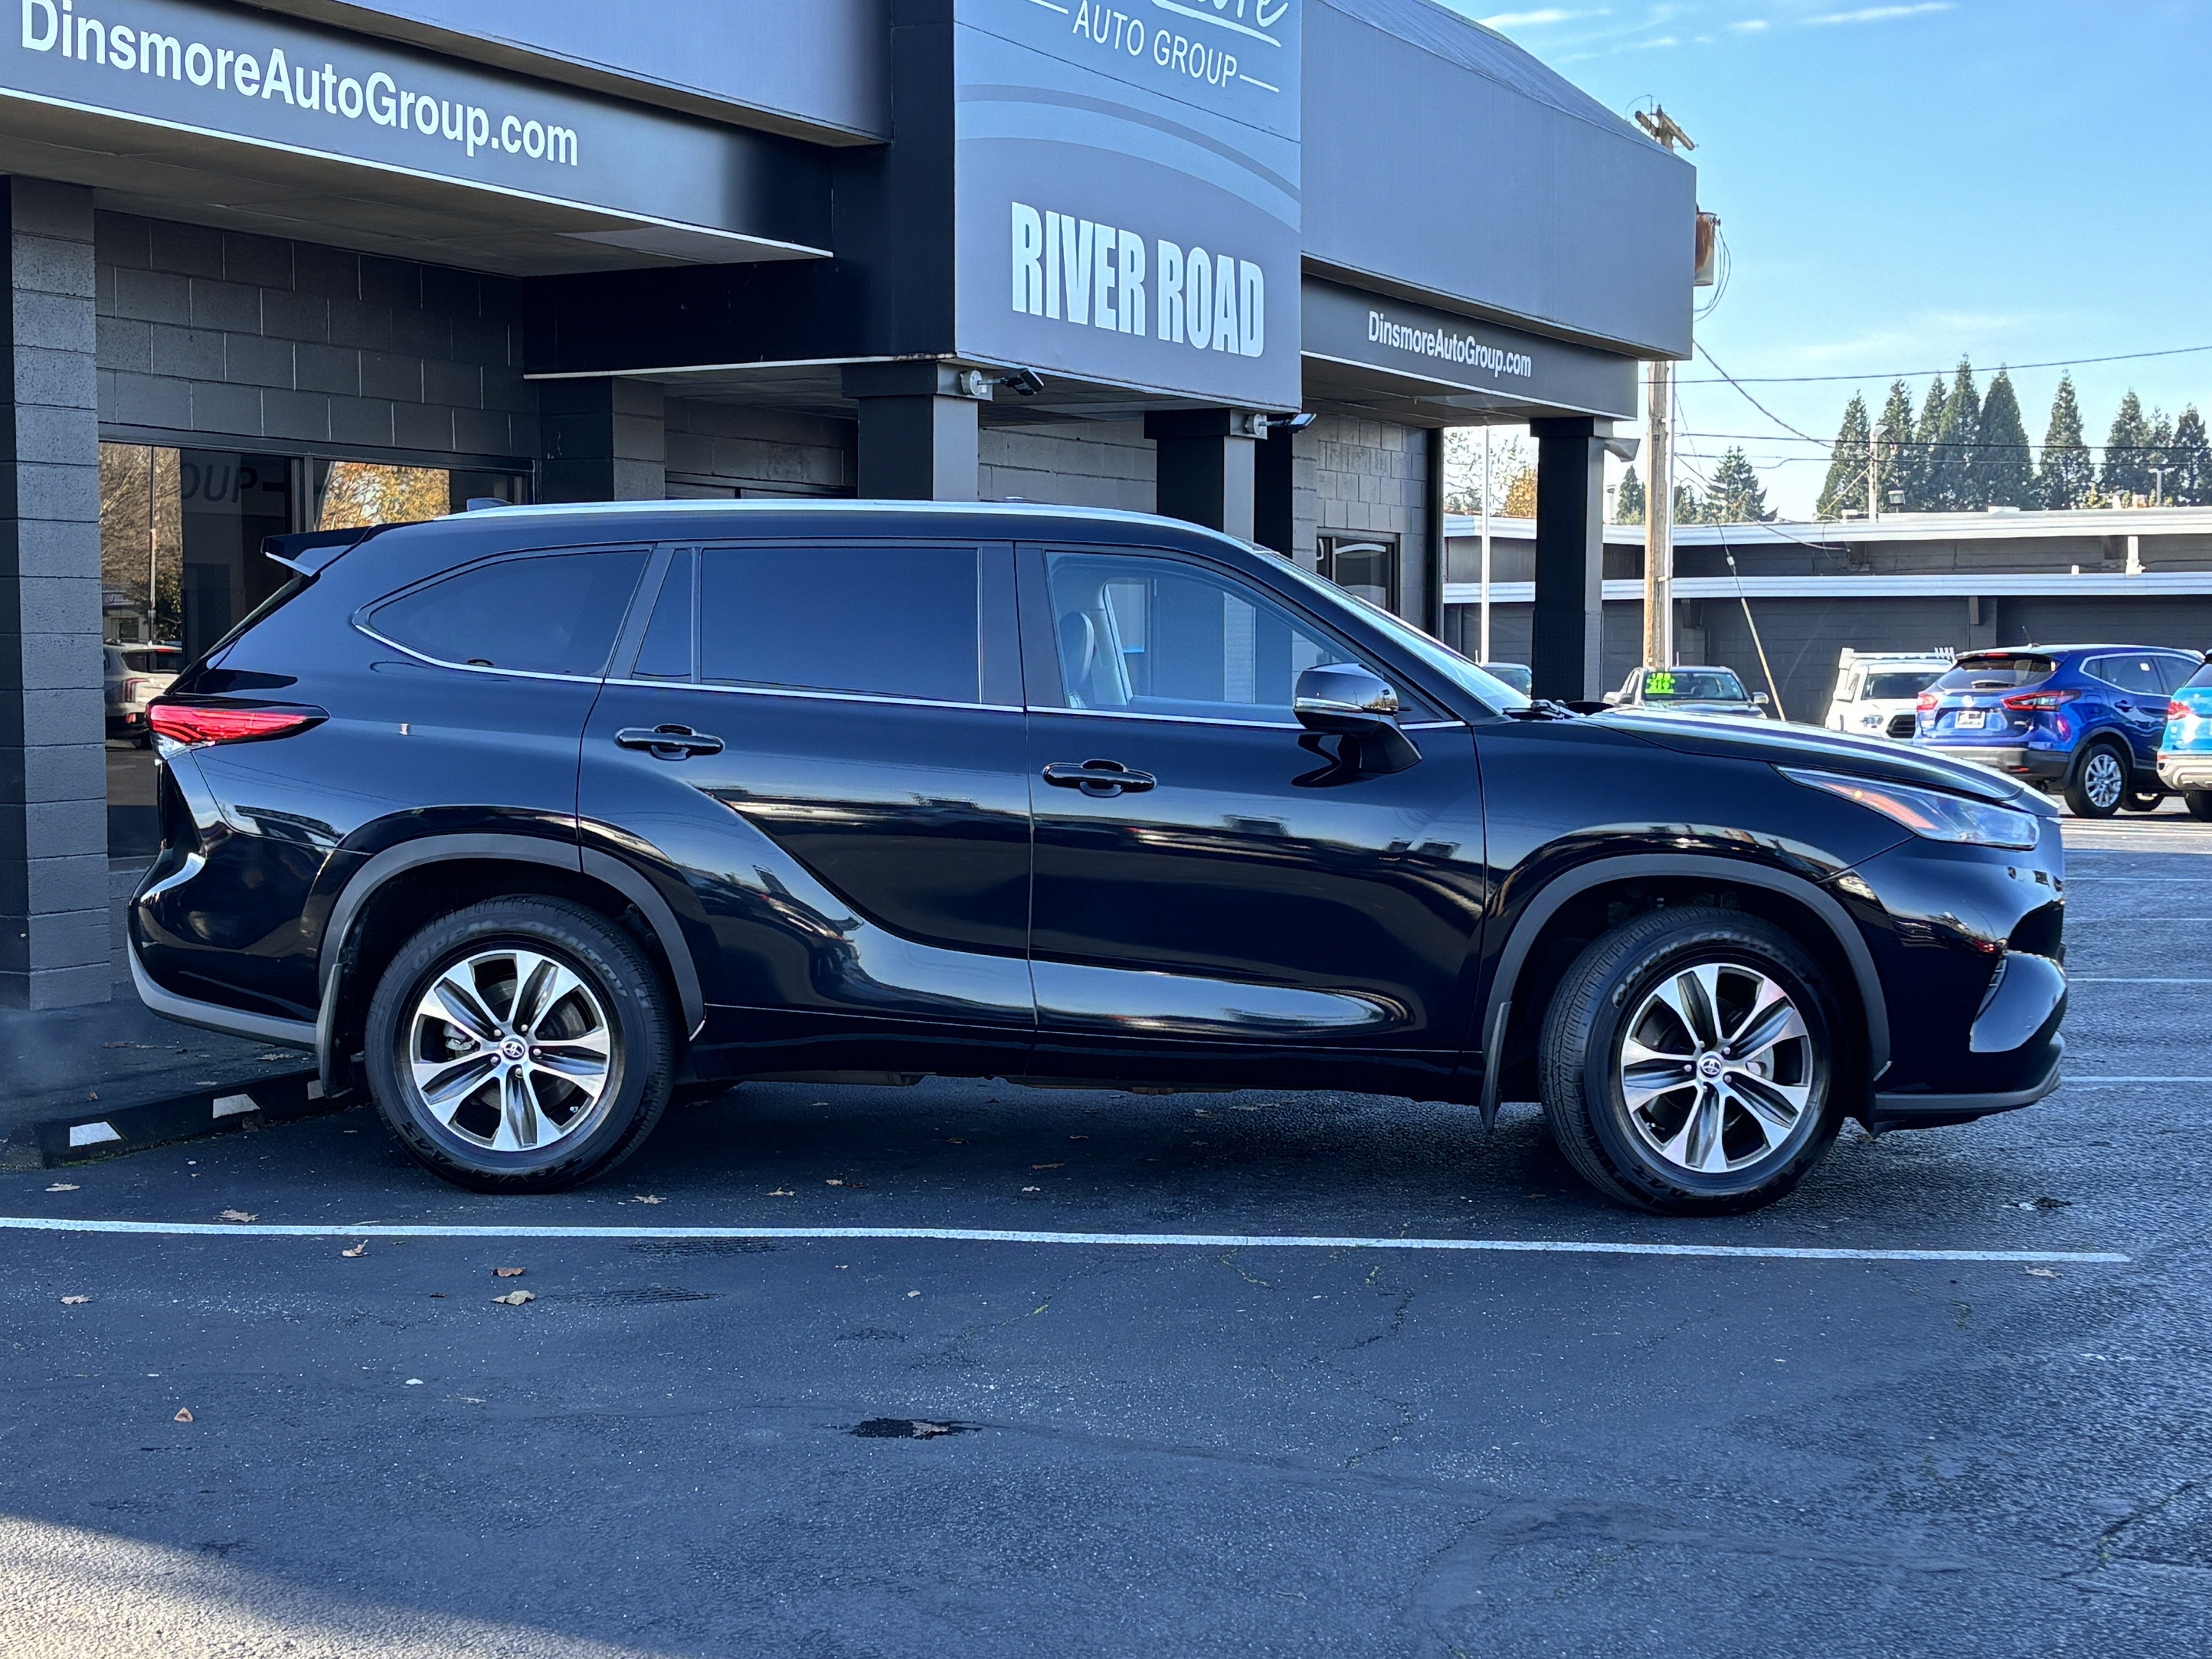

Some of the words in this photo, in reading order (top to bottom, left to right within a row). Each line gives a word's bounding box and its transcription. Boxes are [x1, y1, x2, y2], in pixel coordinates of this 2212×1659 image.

[21, 0, 578, 167] DinsmoreAutoGroup.com
[1072, 5, 1145, 56] AUTO
[1154, 29, 1237, 88] GROUP
[1012, 201, 1146, 336] RIVER
[1158, 239, 1264, 357] ROAD
[1368, 311, 1532, 378] DinsmoreAutoGroup.com
[521, 920, 628, 998] OUNTRY
